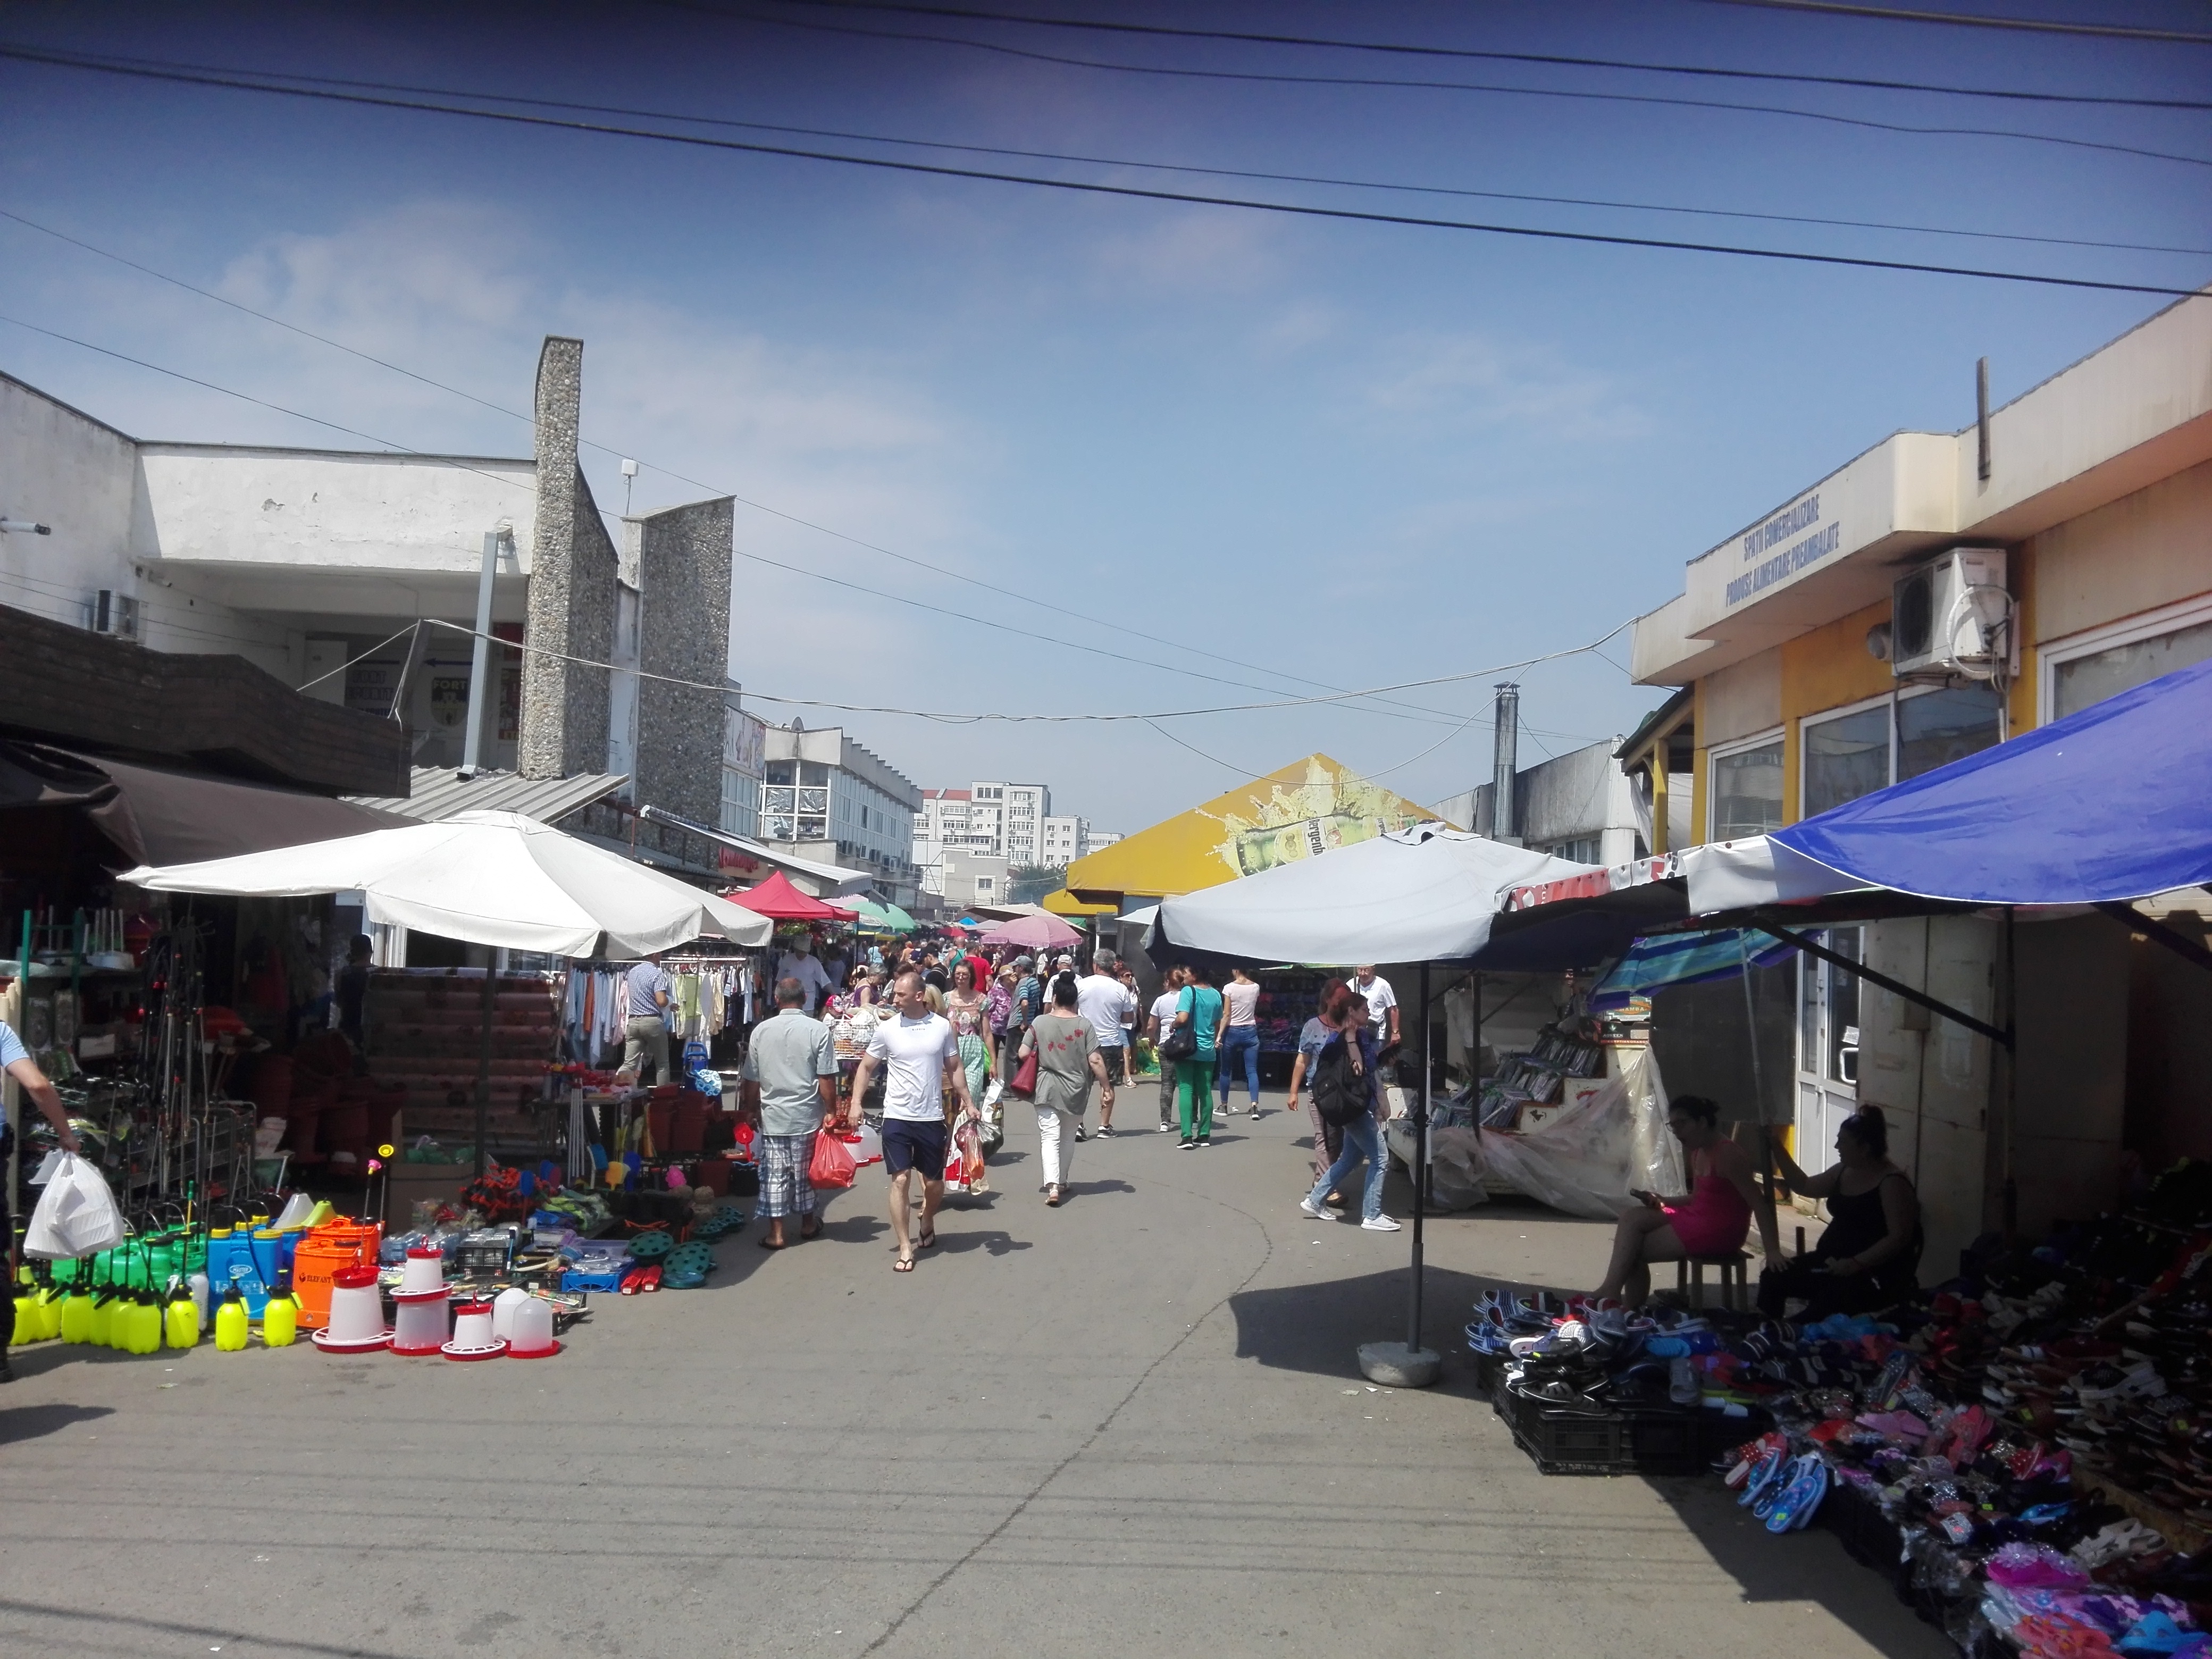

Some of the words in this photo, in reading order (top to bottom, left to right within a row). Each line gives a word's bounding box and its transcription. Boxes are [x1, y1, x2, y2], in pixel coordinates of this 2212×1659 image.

[1765, 494, 1819, 550] COMERCIALIZARE
[1727, 571, 1752, 607] PRODUSE
[1753, 550, 1790, 592] ALIMENTARE
[1791, 521, 1839, 573] PREAMBALATE
[433, 680, 468, 690] FORT
[307, 1275, 332, 1284] ELEFANT
